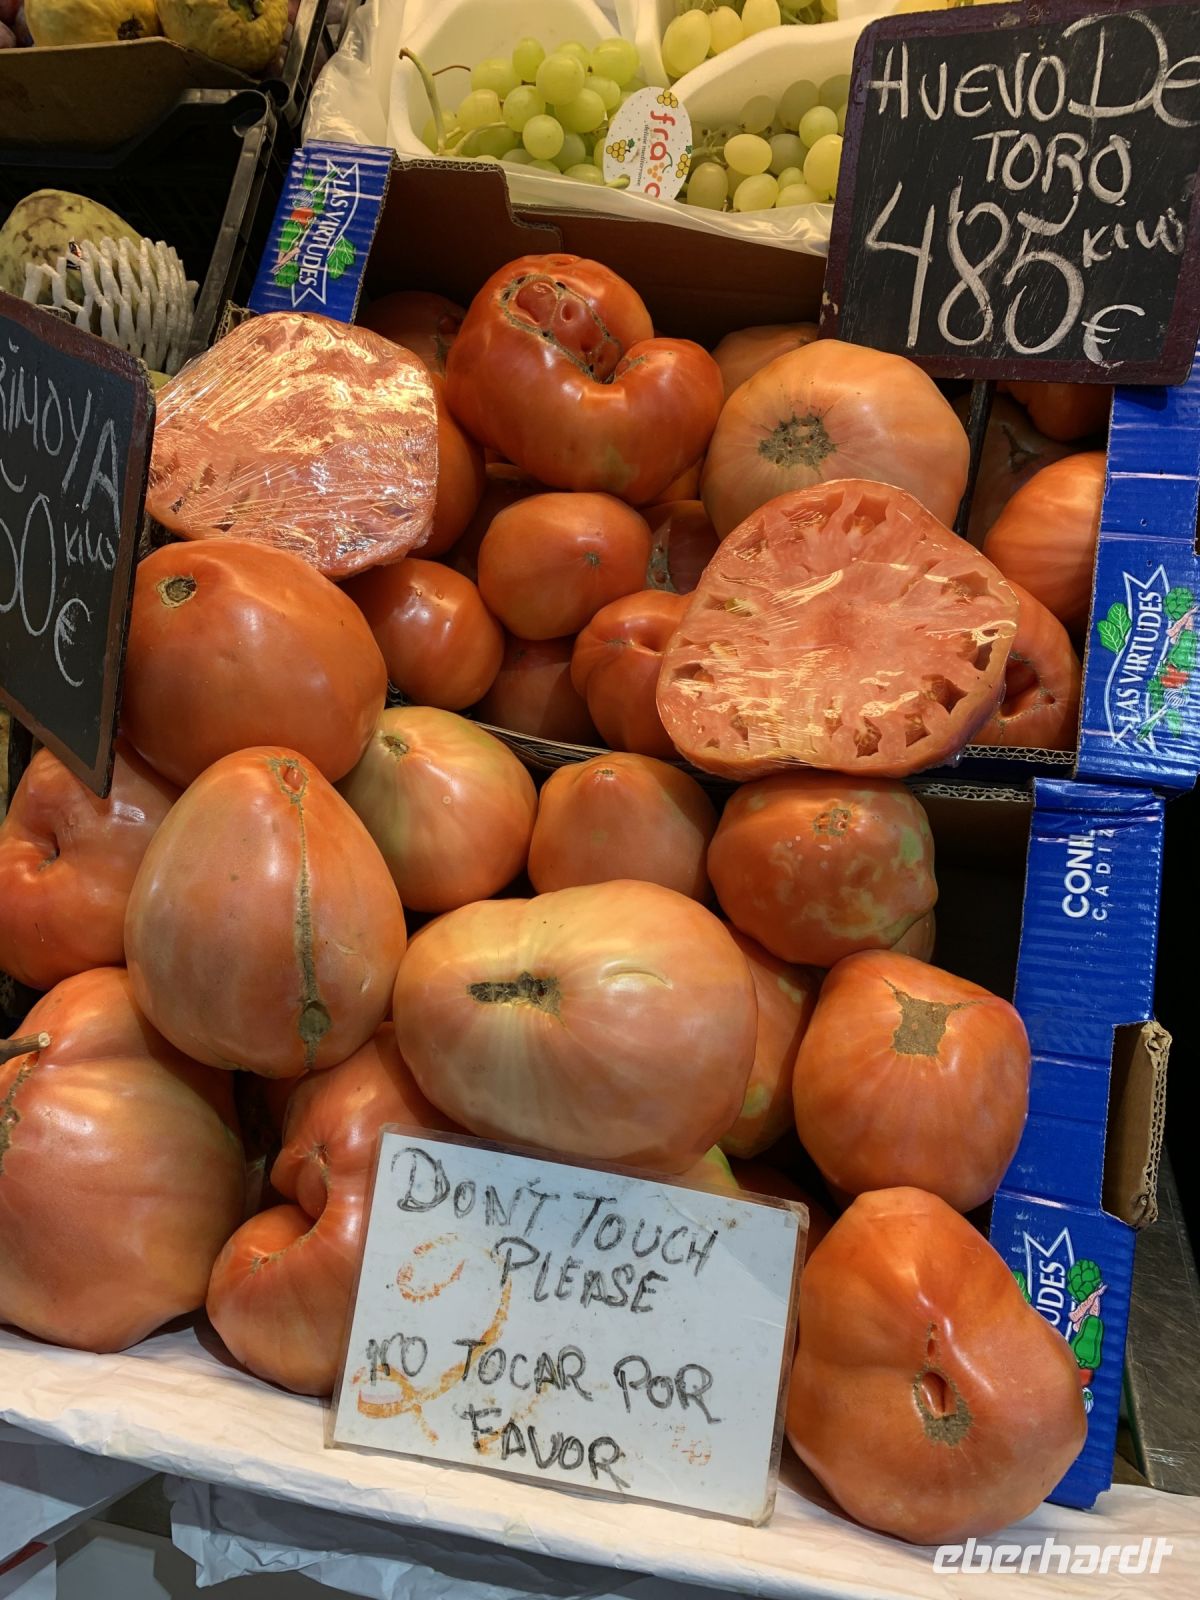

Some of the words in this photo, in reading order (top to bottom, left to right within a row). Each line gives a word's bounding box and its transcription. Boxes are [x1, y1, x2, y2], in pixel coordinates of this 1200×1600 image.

[866, 42, 1066, 121] HUEVO
[328, 180, 350, 208] LAS
[972, 130, 1132, 206] TORO
[298, 211, 346, 287] VIRTUDES
[1081, 304, 1146, 370] €
[54, 598, 92, 687] €
[1119, 591, 1163, 684] VIRTUDES
[1116, 687, 1142, 723] LAS
[572, 1191, 718, 1277] TOUCH
[490, 1236, 669, 1313] PLEASE
[366, 1333, 428, 1387] NO
[453, 1338, 594, 1402] TOCAR
[614, 1355, 722, 1424] POR
[453, 1403, 632, 1492] FAVOR
